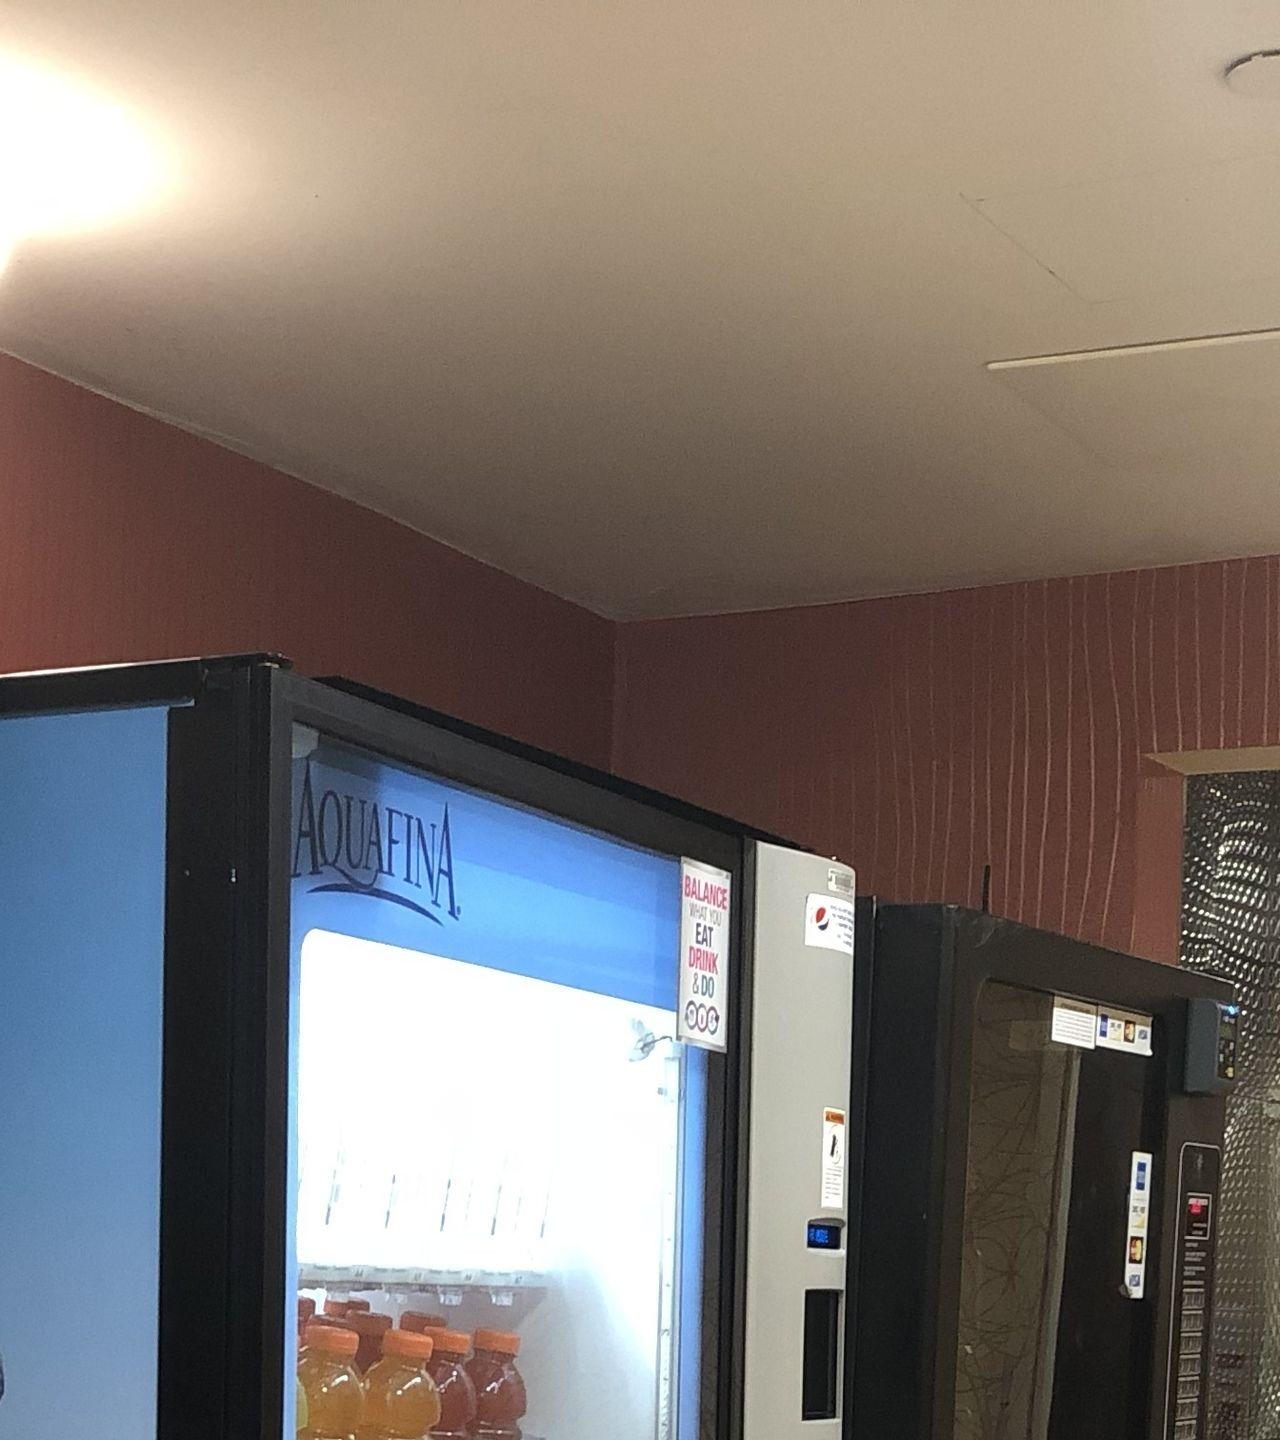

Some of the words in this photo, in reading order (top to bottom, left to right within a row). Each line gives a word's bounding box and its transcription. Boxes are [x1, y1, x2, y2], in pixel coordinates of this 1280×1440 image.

[290, 756, 460, 921] AQUAFINA
[684, 874, 728, 911] BALANCE
[689, 902, 708, 920] WHAT
[695, 922, 714, 948] EAT
[688, 946, 719, 975] DRINK
[692, 972, 699, 995] &
[701, 974, 715, 998] DO
